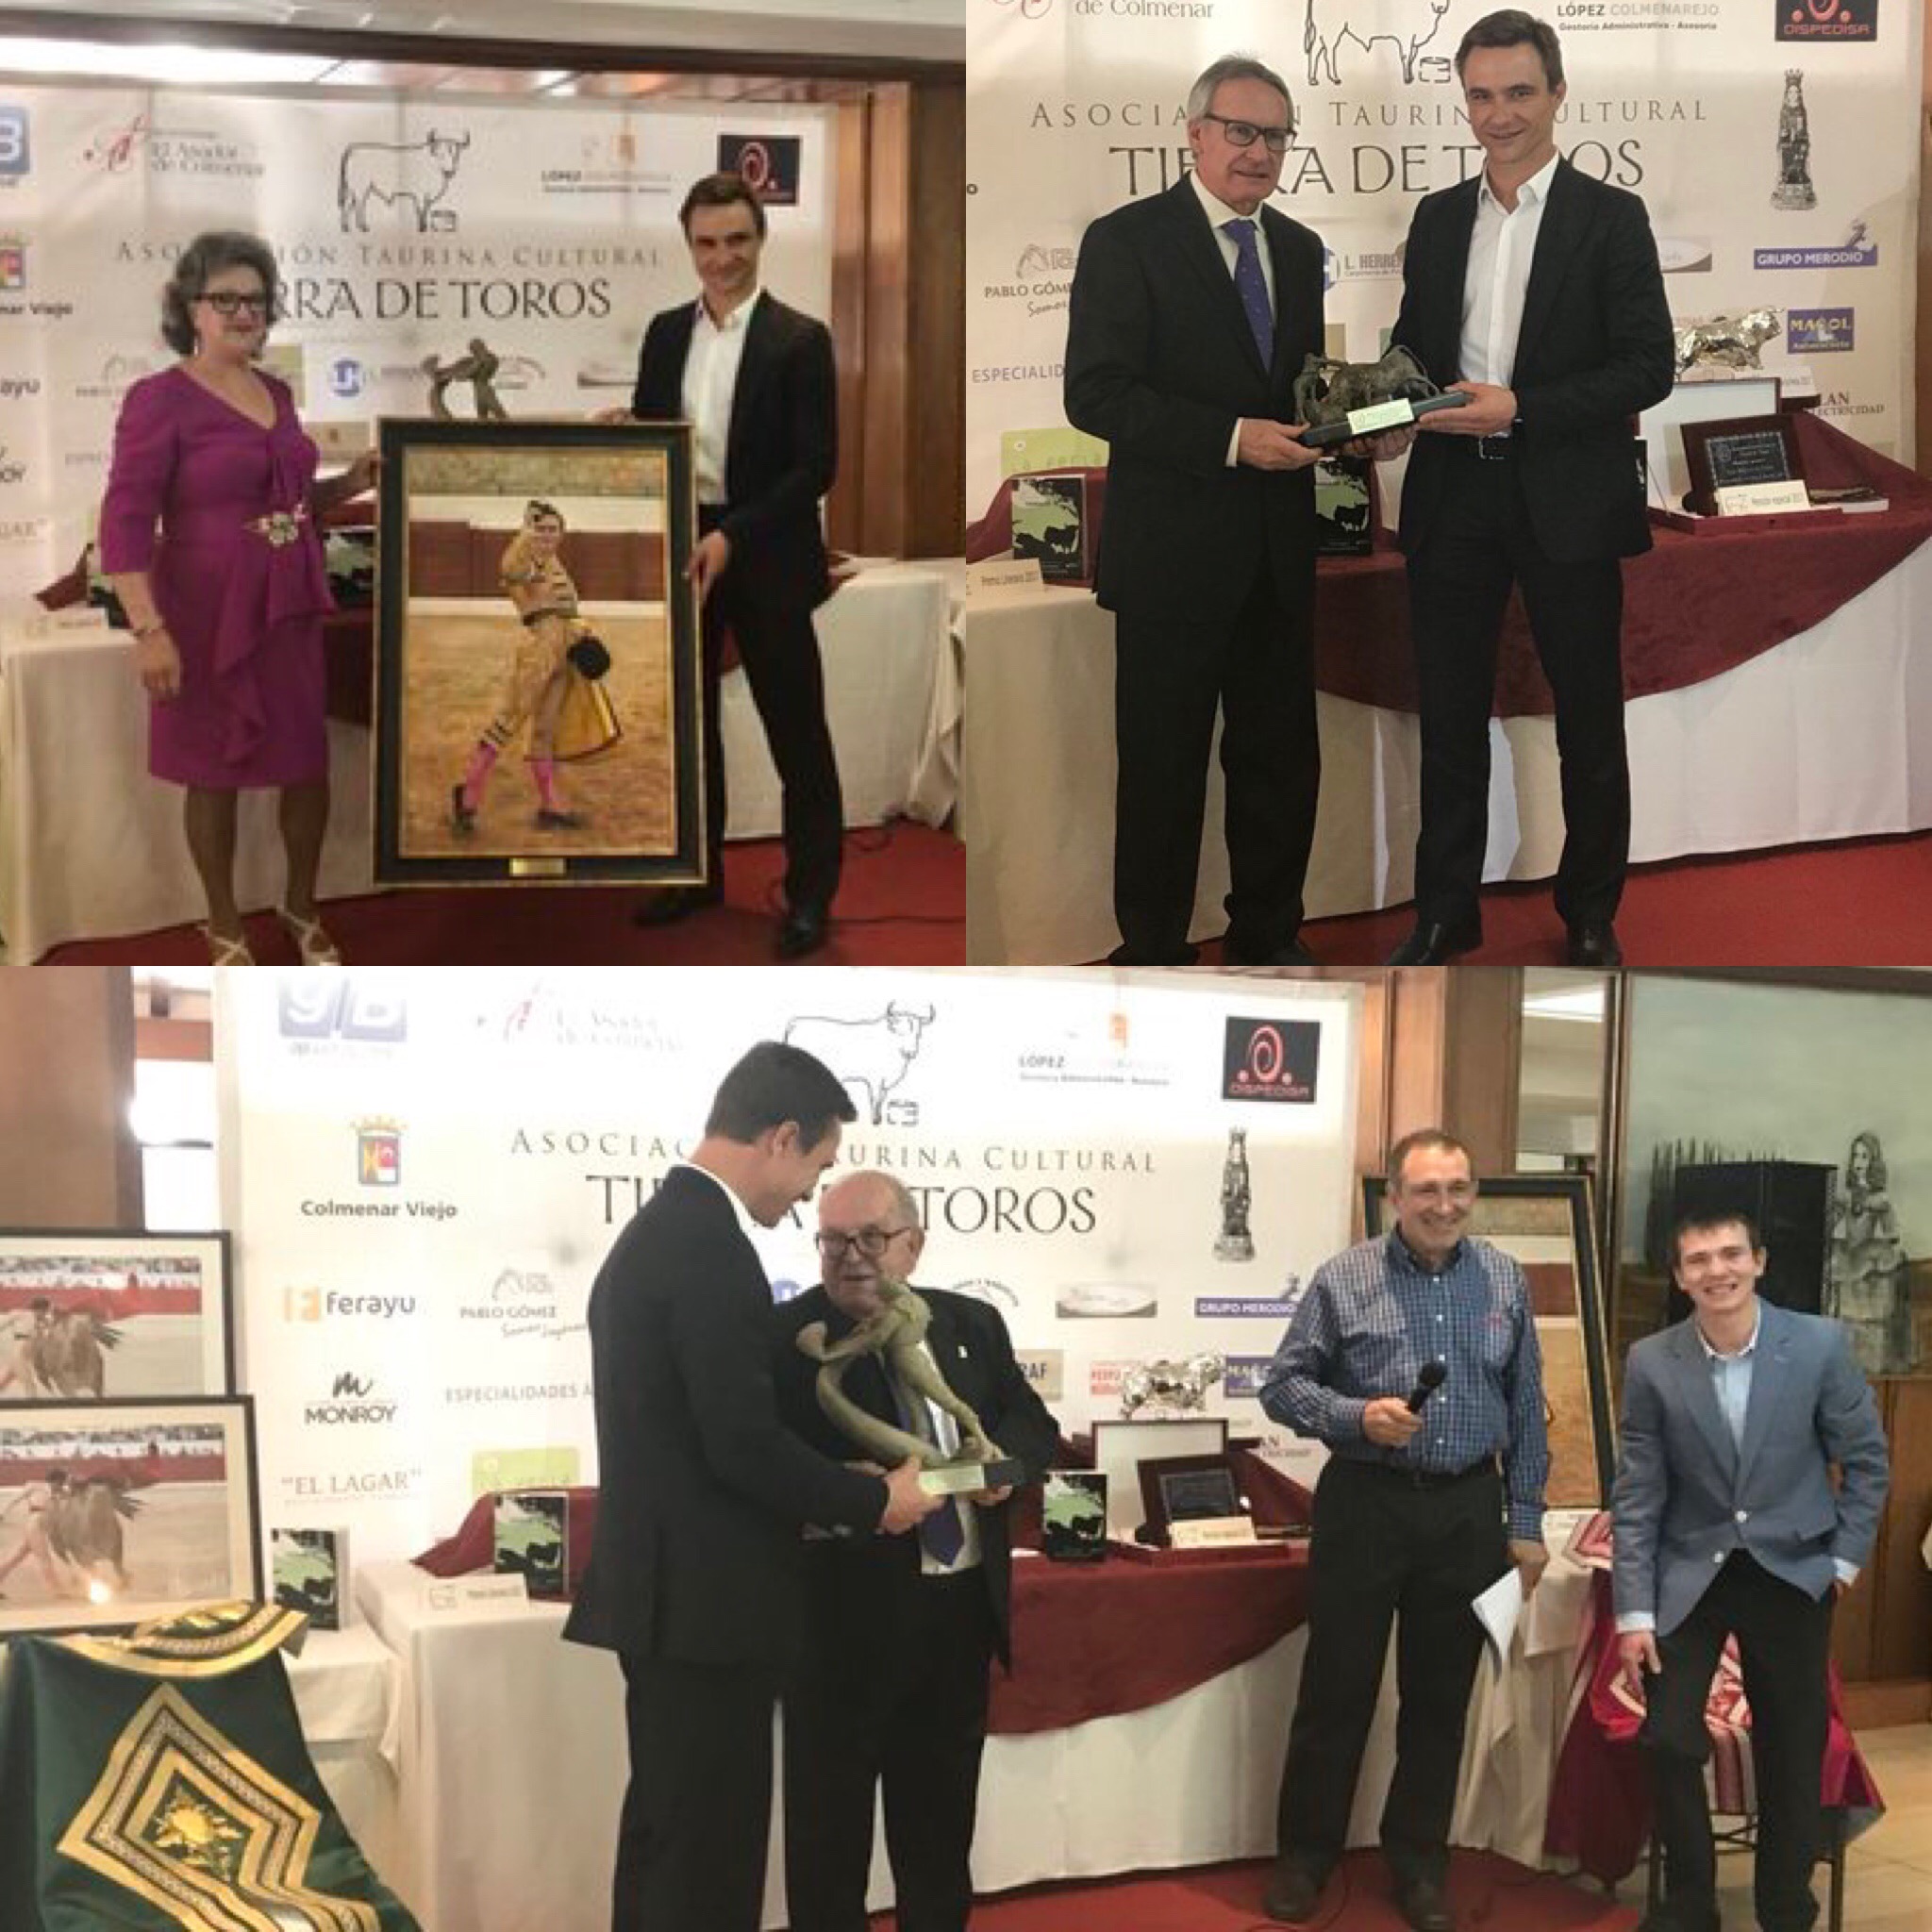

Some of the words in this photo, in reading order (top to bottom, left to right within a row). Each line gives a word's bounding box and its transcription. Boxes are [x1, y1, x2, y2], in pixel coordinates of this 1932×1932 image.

[1557, 3, 1605, 18] LÓPEZ
[1609, 3, 1721, 16] COLMENAREJO
[1328, 100, 1472, 126] TAURIN
[1553, 98, 1707, 125] ULTURAL
[1352, 143, 1430, 194] DE
[1757, 253, 1802, 265] GRUPO
[1804, 250, 1863, 264] MERODIO
[375, 277, 439, 318] DE
[447, 275, 611, 319] TOROS
[984, 285, 1028, 298] PABLO
[972, 363, 1064, 383] ESPECIALID
[848, 1143, 961, 1169] URINA
[983, 1145, 1156, 1173] CULTURAL
[300, 1199, 401, 1217] Colmenar
[406, 1200, 458, 1222] Viejo
[908, 1185, 1096, 1234] TOROS
[326, 1291, 417, 1318] ferayu
[304, 1405, 398, 1424] MONROY
